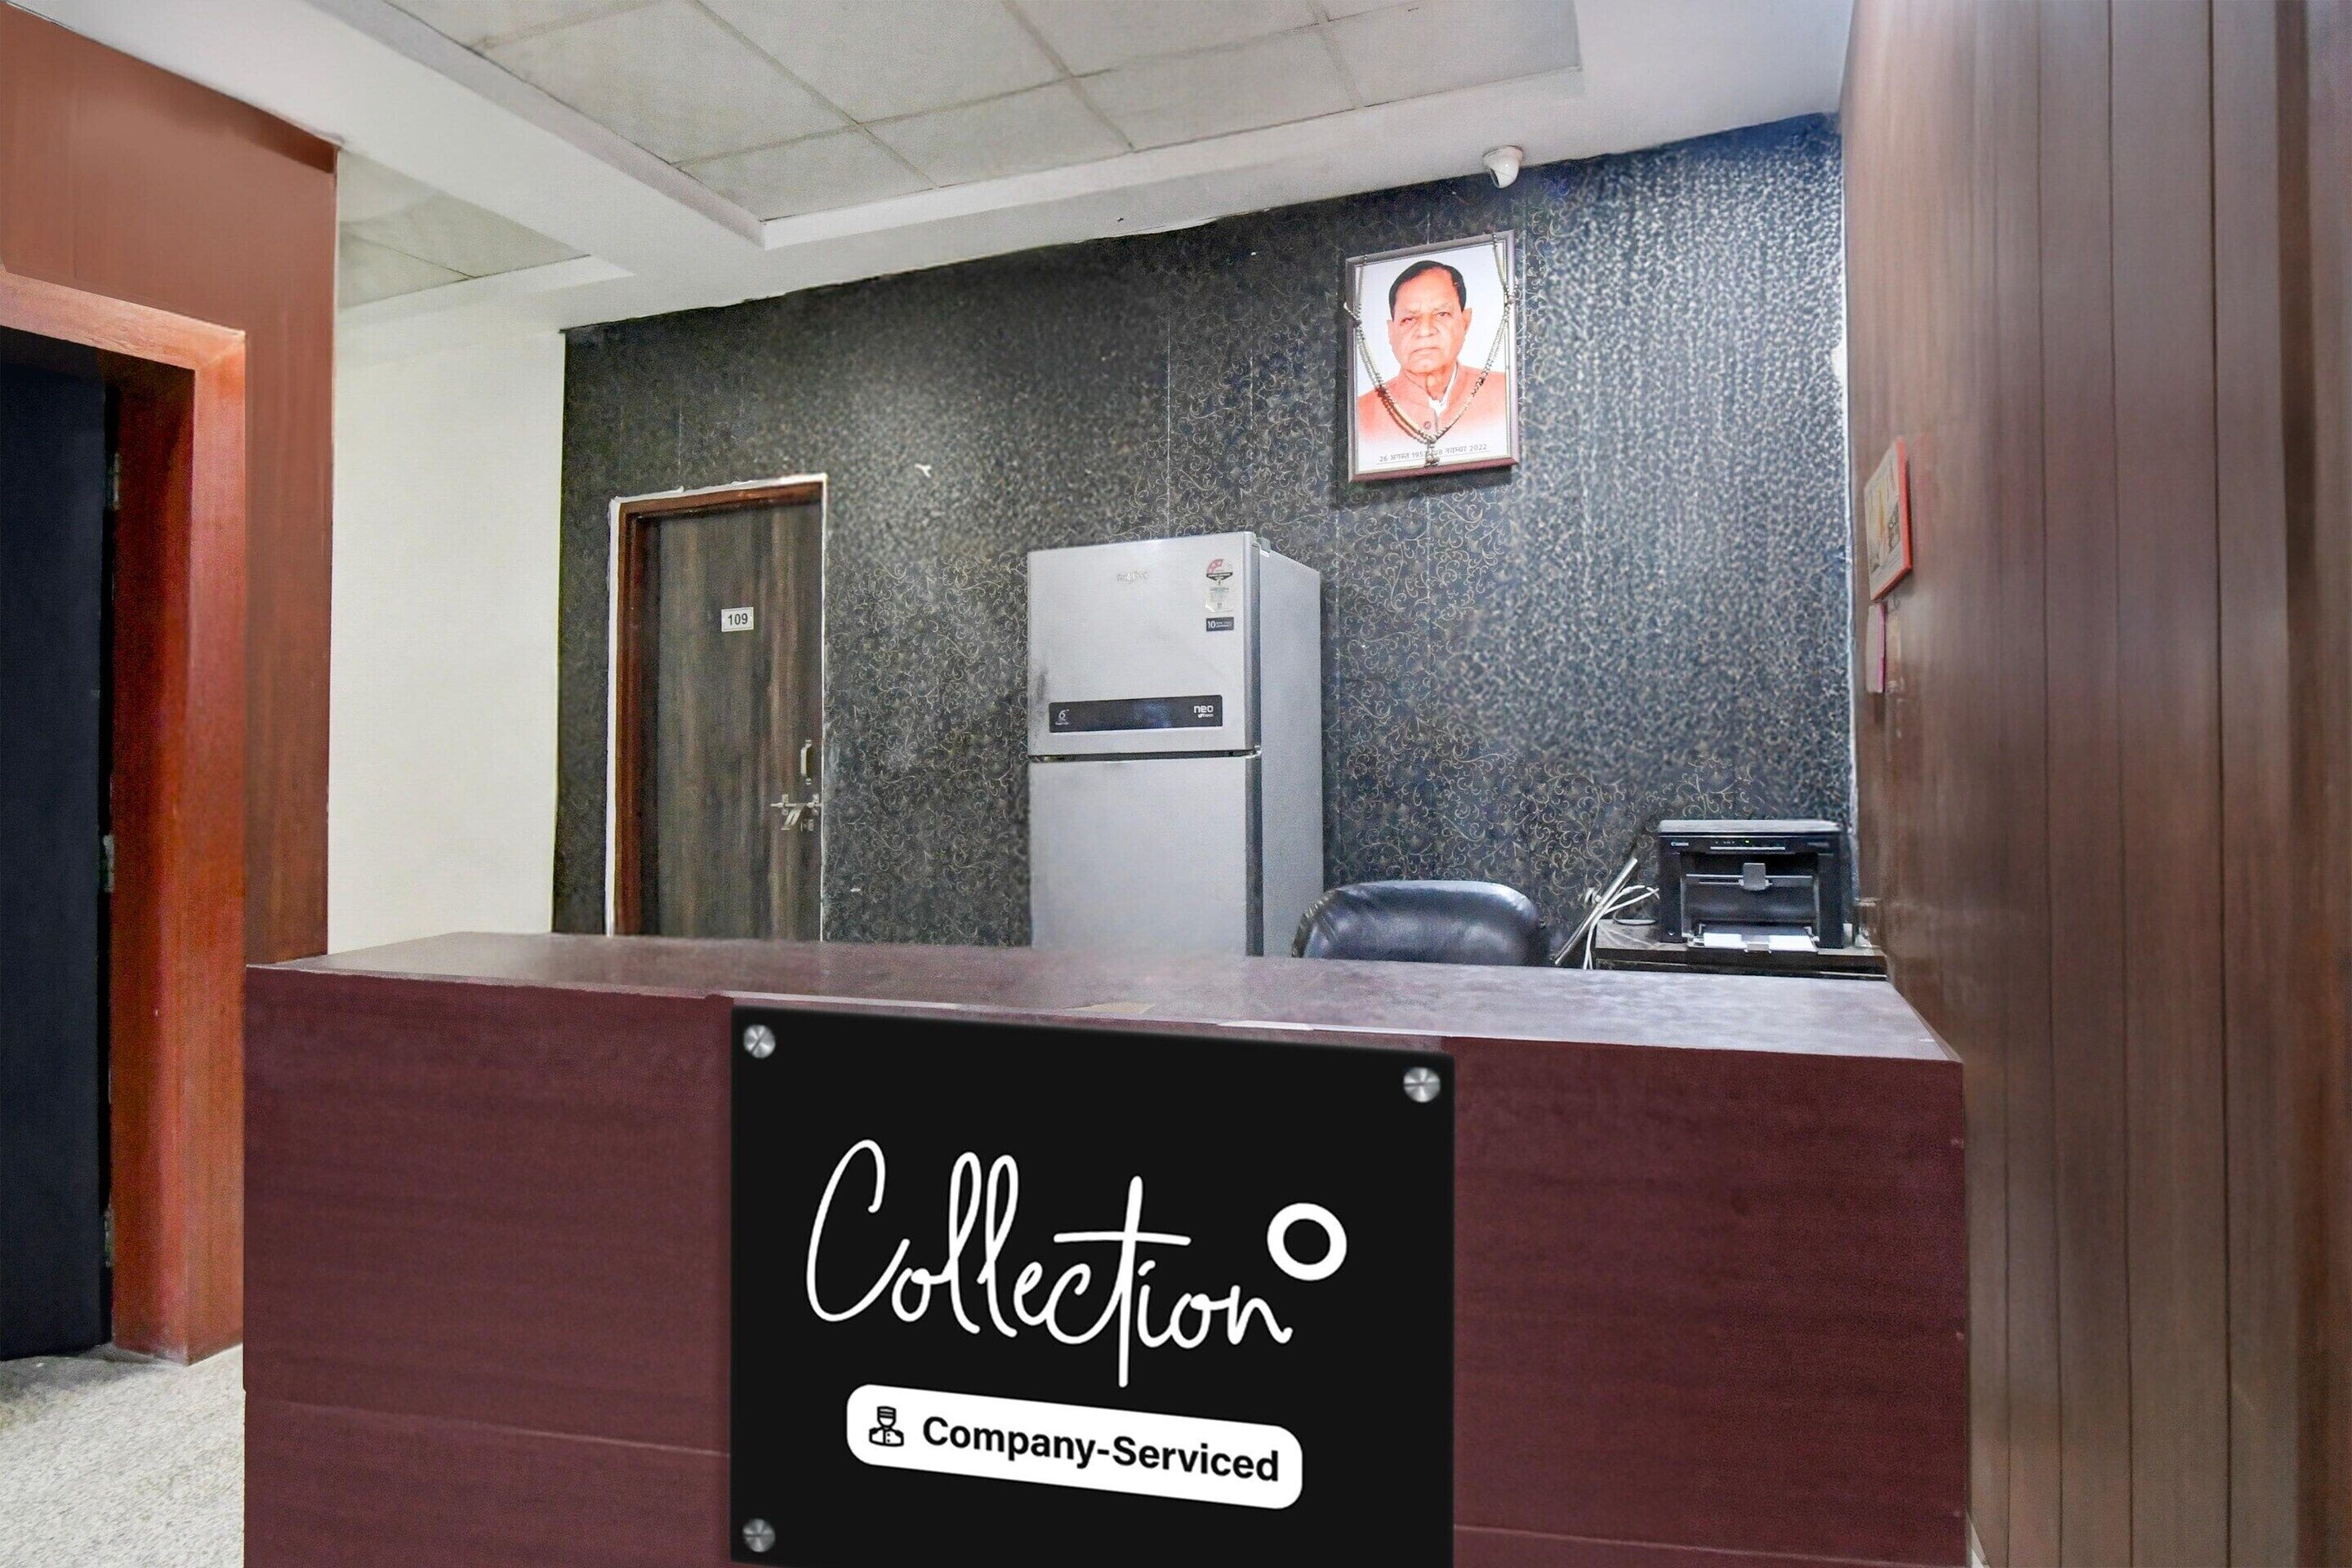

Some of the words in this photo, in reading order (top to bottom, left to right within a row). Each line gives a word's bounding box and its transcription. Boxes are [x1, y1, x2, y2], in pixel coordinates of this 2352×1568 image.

[1469, 443, 1487, 452] 2022
[728, 612, 748, 626] 109
[1207, 620, 1216, 629] 10
[1193, 705, 1214, 714] neo
[807, 1140, 1293, 1388] Collection
[923, 1416, 1279, 1482] Company-Serviced
